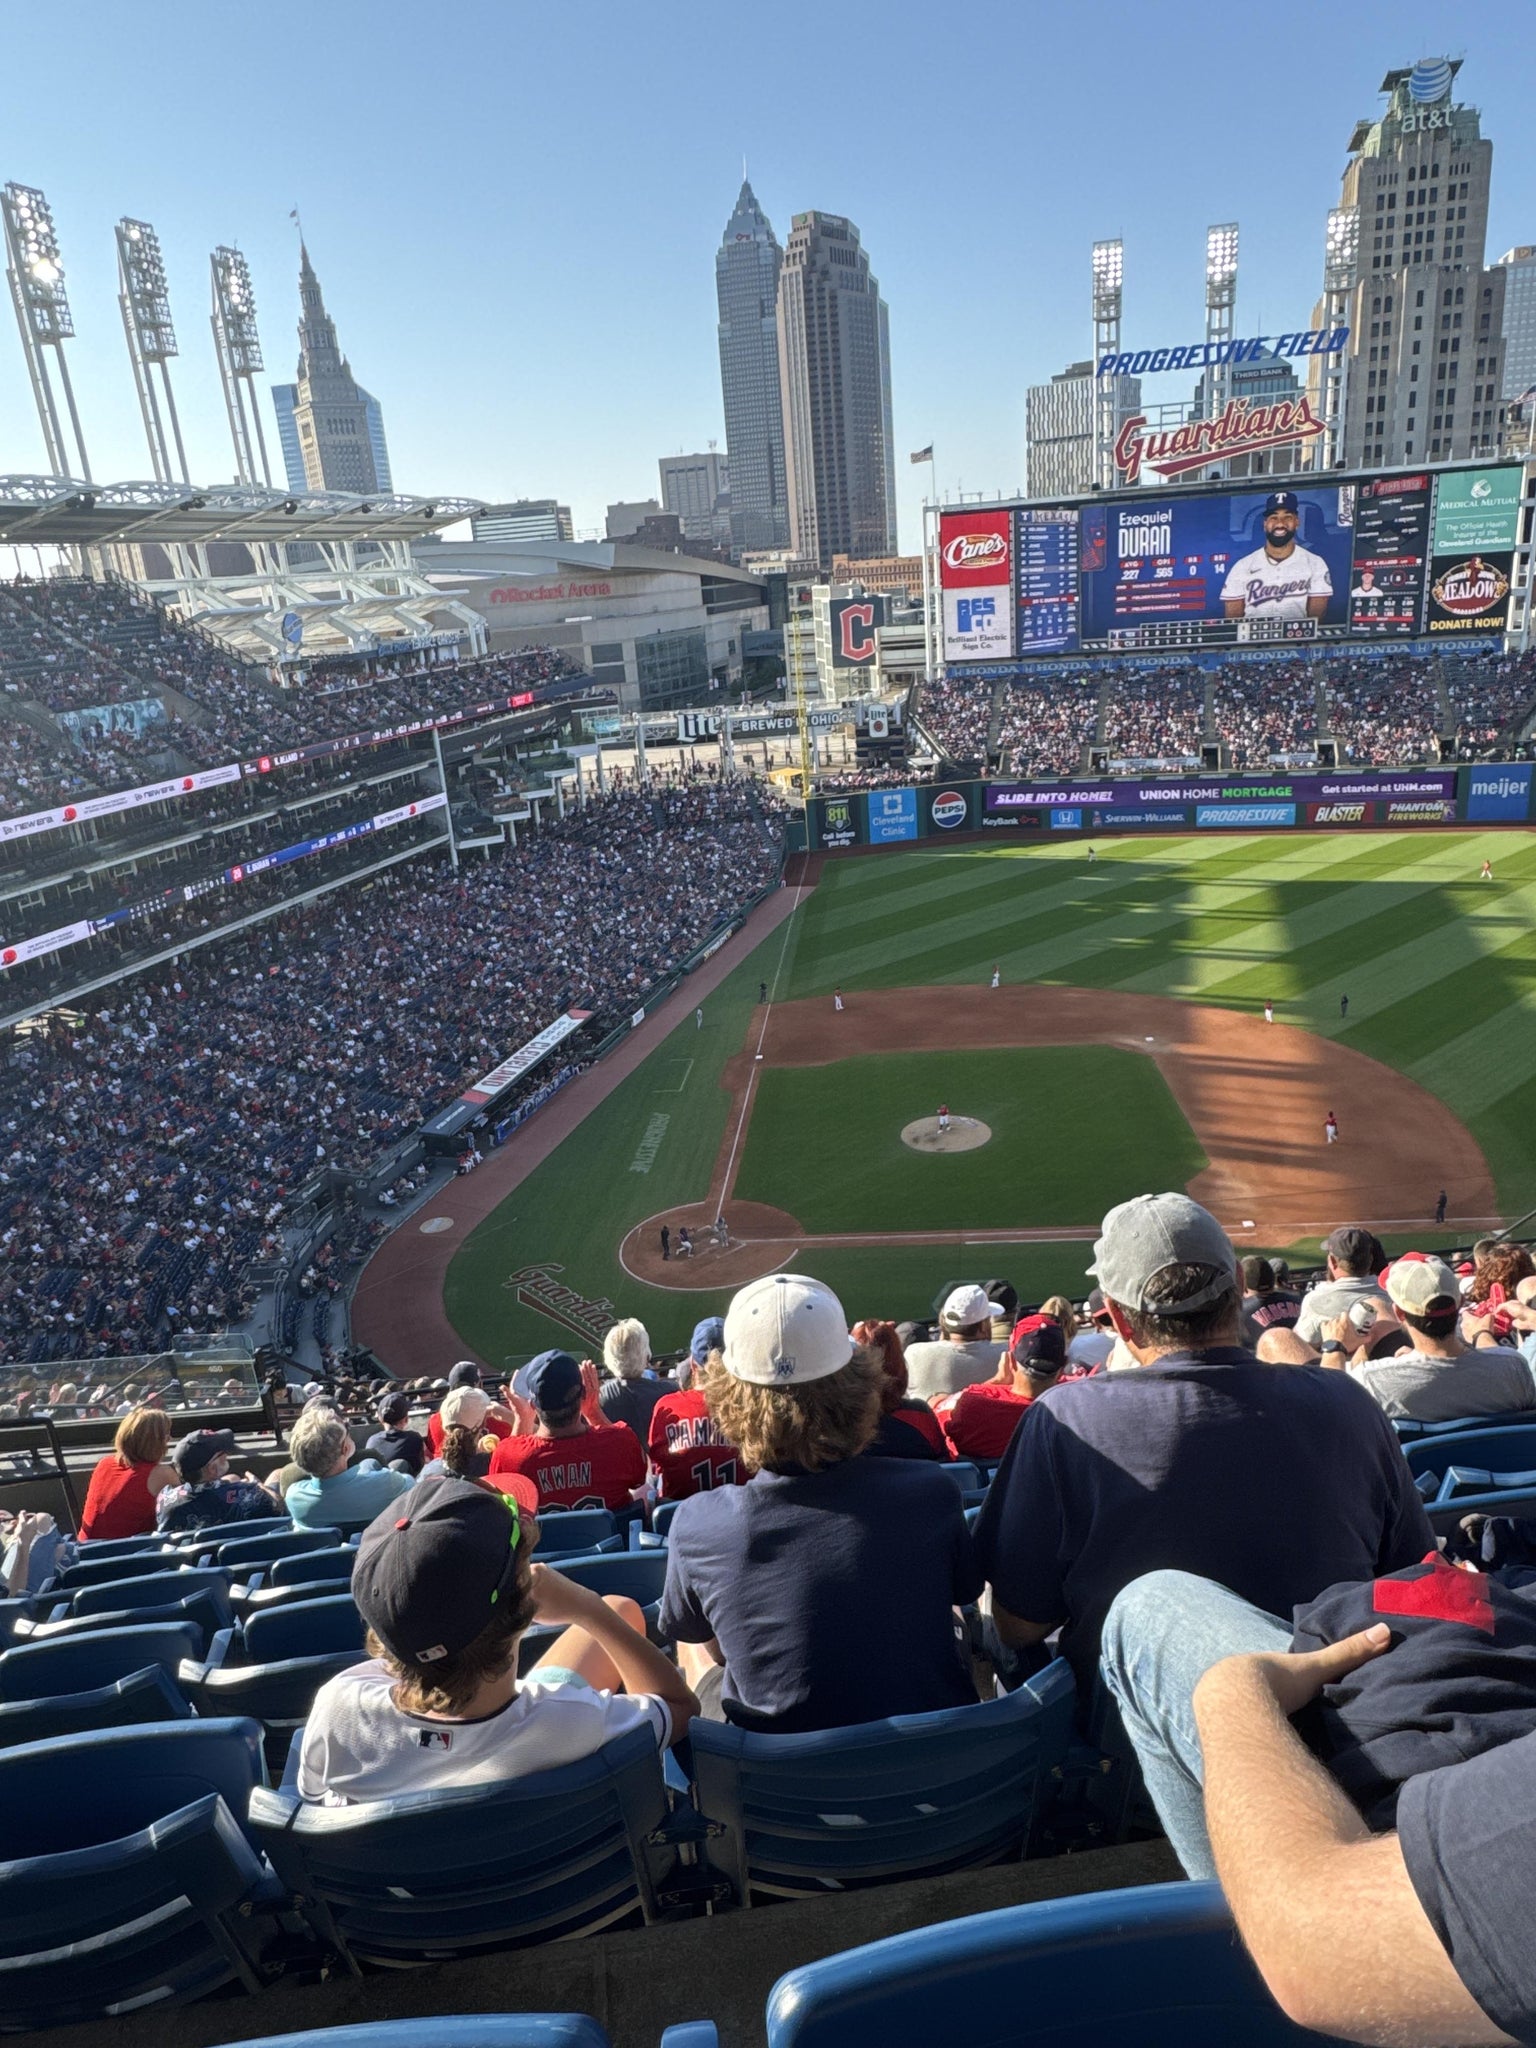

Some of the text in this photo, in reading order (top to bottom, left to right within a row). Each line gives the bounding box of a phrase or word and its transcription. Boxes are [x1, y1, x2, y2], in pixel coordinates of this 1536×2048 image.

[1401, 103, 1454, 133] at&t
[1096, 327, 1350, 378] PROGRESSIVE FIELD
[1234, 368, 1283, 379] THIRD BANK
[1113, 395, 1327, 484] Guardians
[1275, 492, 1287, 504] T
[1439, 497, 1517, 510] MEDICAL MUTUAL
[1120, 509, 1172, 527] Ezequiel
[1118, 525, 1170, 558] DURAN
[947, 533, 1005, 567] Cane's
[1189, 566, 1196, 575] 0
[1214, 563, 1226, 574] 14
[510, 582, 612, 603] Rocket Arena
[1246, 577, 1312, 606] Rangers
[1430, 616, 1504, 631] DONATE NOW!
[839, 603, 876, 661] C
[947, 633, 1008, 644] Brilliant Electric
[962, 641, 993, 651] Sign Co.
[1348, 644, 1410, 655] HONDA
[1430, 640, 1495, 650] HONDA
[1136, 656, 1193, 666] HONDA
[1240, 650, 1301, 660] HONDA
[964, 665, 1018, 675] HONDA
[1036, 660, 1090, 670] HONDA
[870, 709, 886, 720] Lite
[677, 711, 721, 742] Lite
[742, 717, 793, 732] BREWED
[811, 712, 840, 726] OHIO
[1140, 786, 1292, 800] UNION HOME MORTGAGE
[1322, 782, 1443, 794] Get started at UHM.com
[1471, 778, 1528, 798] meijer
[996, 791, 1113, 803] SLIDE INTO HOME!
[934, 803, 965, 815] PEPSI
[1315, 805, 1365, 822] BLASTER
[1389, 802, 1444, 812] PHANTOM
[828, 806, 847, 822] 811
[872, 813, 915, 826] Cleveland
[1199, 808, 1292, 821] PROGRESSIVE
[1387, 811, 1442, 821] FIREWORKS
[983, 816, 1019, 826] KeyBank
[822, 830, 856, 841] Call before
[881, 826, 907, 837] Clinic
[481, 1041, 550, 1087] CLEVELAND
[502, 1263, 621, 1338] Guardia
[537, 1461, 591, 1493] KWAN
[691, 1458, 737, 1491] 11
